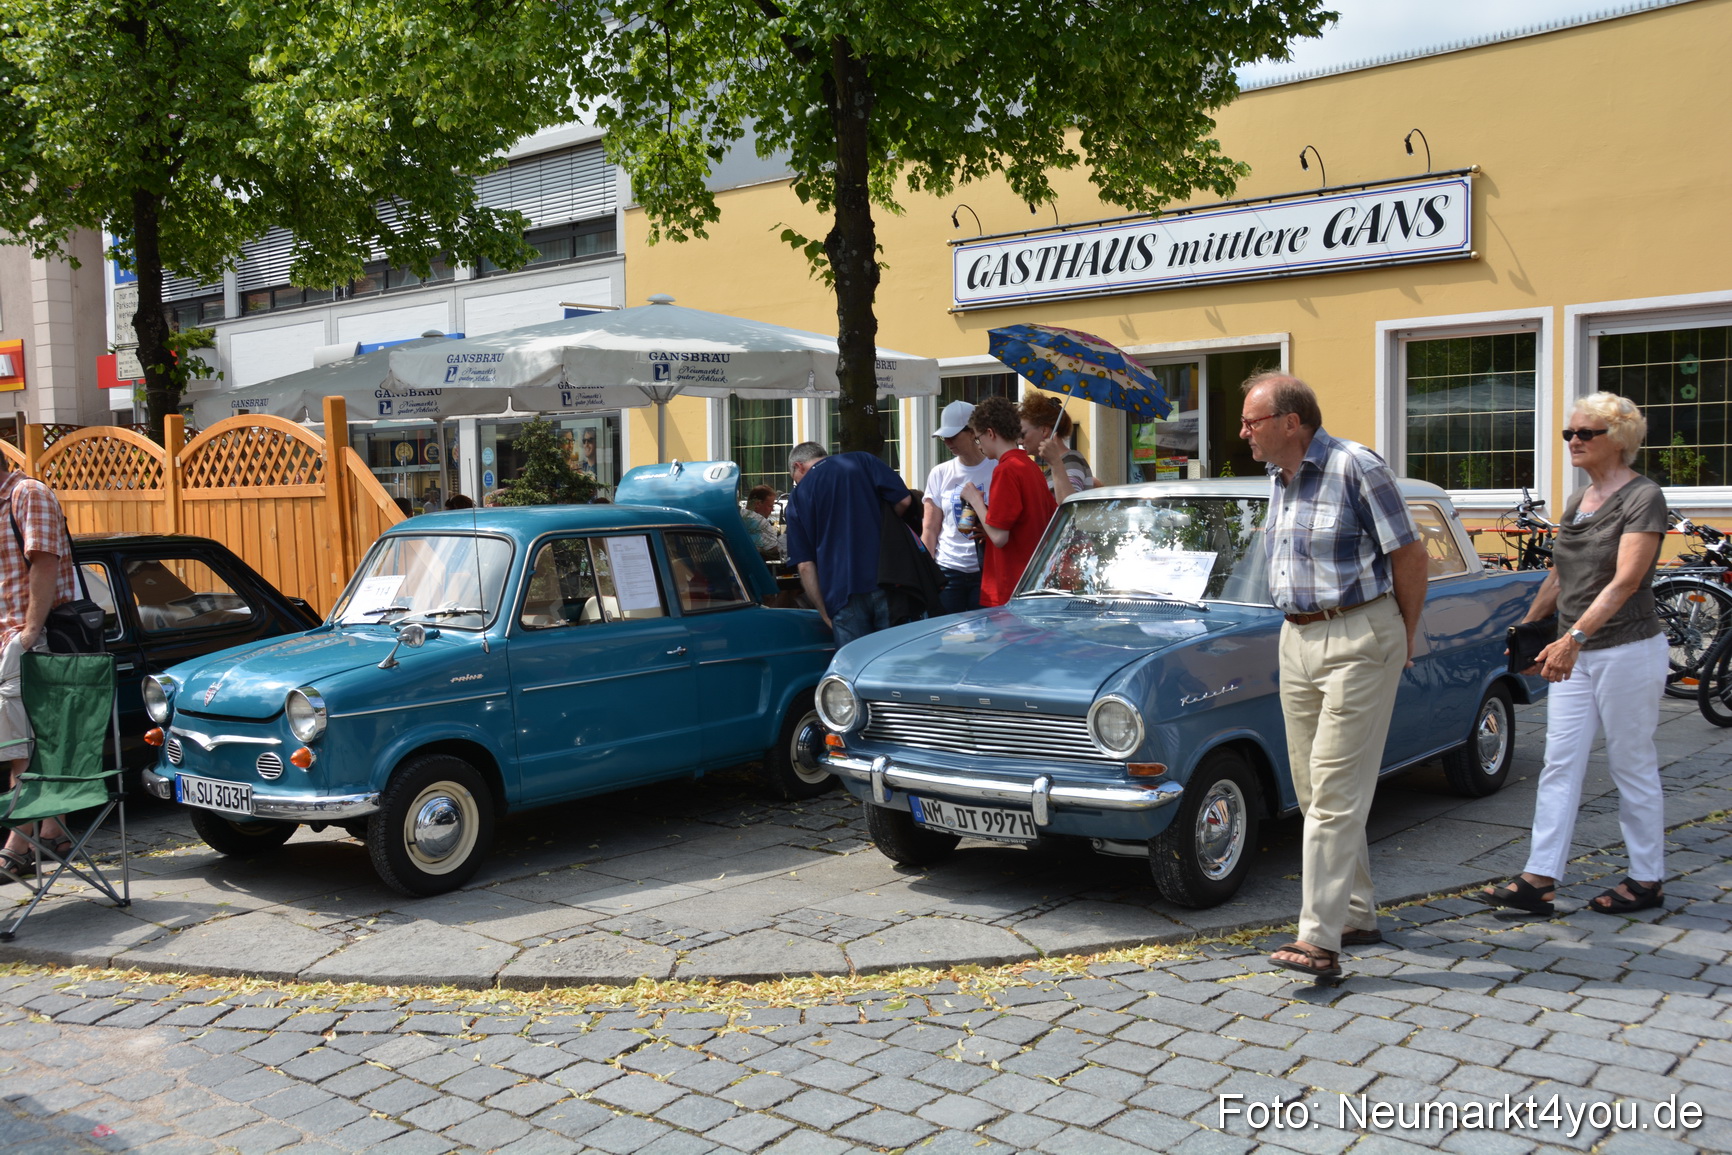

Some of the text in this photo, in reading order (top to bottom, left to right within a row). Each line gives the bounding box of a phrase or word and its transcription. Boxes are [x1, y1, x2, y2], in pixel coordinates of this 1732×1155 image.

[966, 193, 1450, 291] GASTHAUS mittlere GANS
[116, 302, 137, 311] Parksche
[446, 353, 505, 364] GANSBRÄU
[648, 351, 731, 364] GANSBRÄU
[678, 365, 725, 375] Neumarkt's
[875, 359, 897, 371] BRÄU
[461, 366, 497, 376] Neumarkt's
[676, 374, 697, 382] guter
[231, 398, 270, 408] GANSBRÄU
[399, 400, 438, 409] Neumarkt's
[891, 690, 1038, 709] OPEL
[182, 778, 190, 801] N
[197, 781, 213, 806] SU
[920, 800, 945, 825] NM
[954, 807, 978, 830] DT
